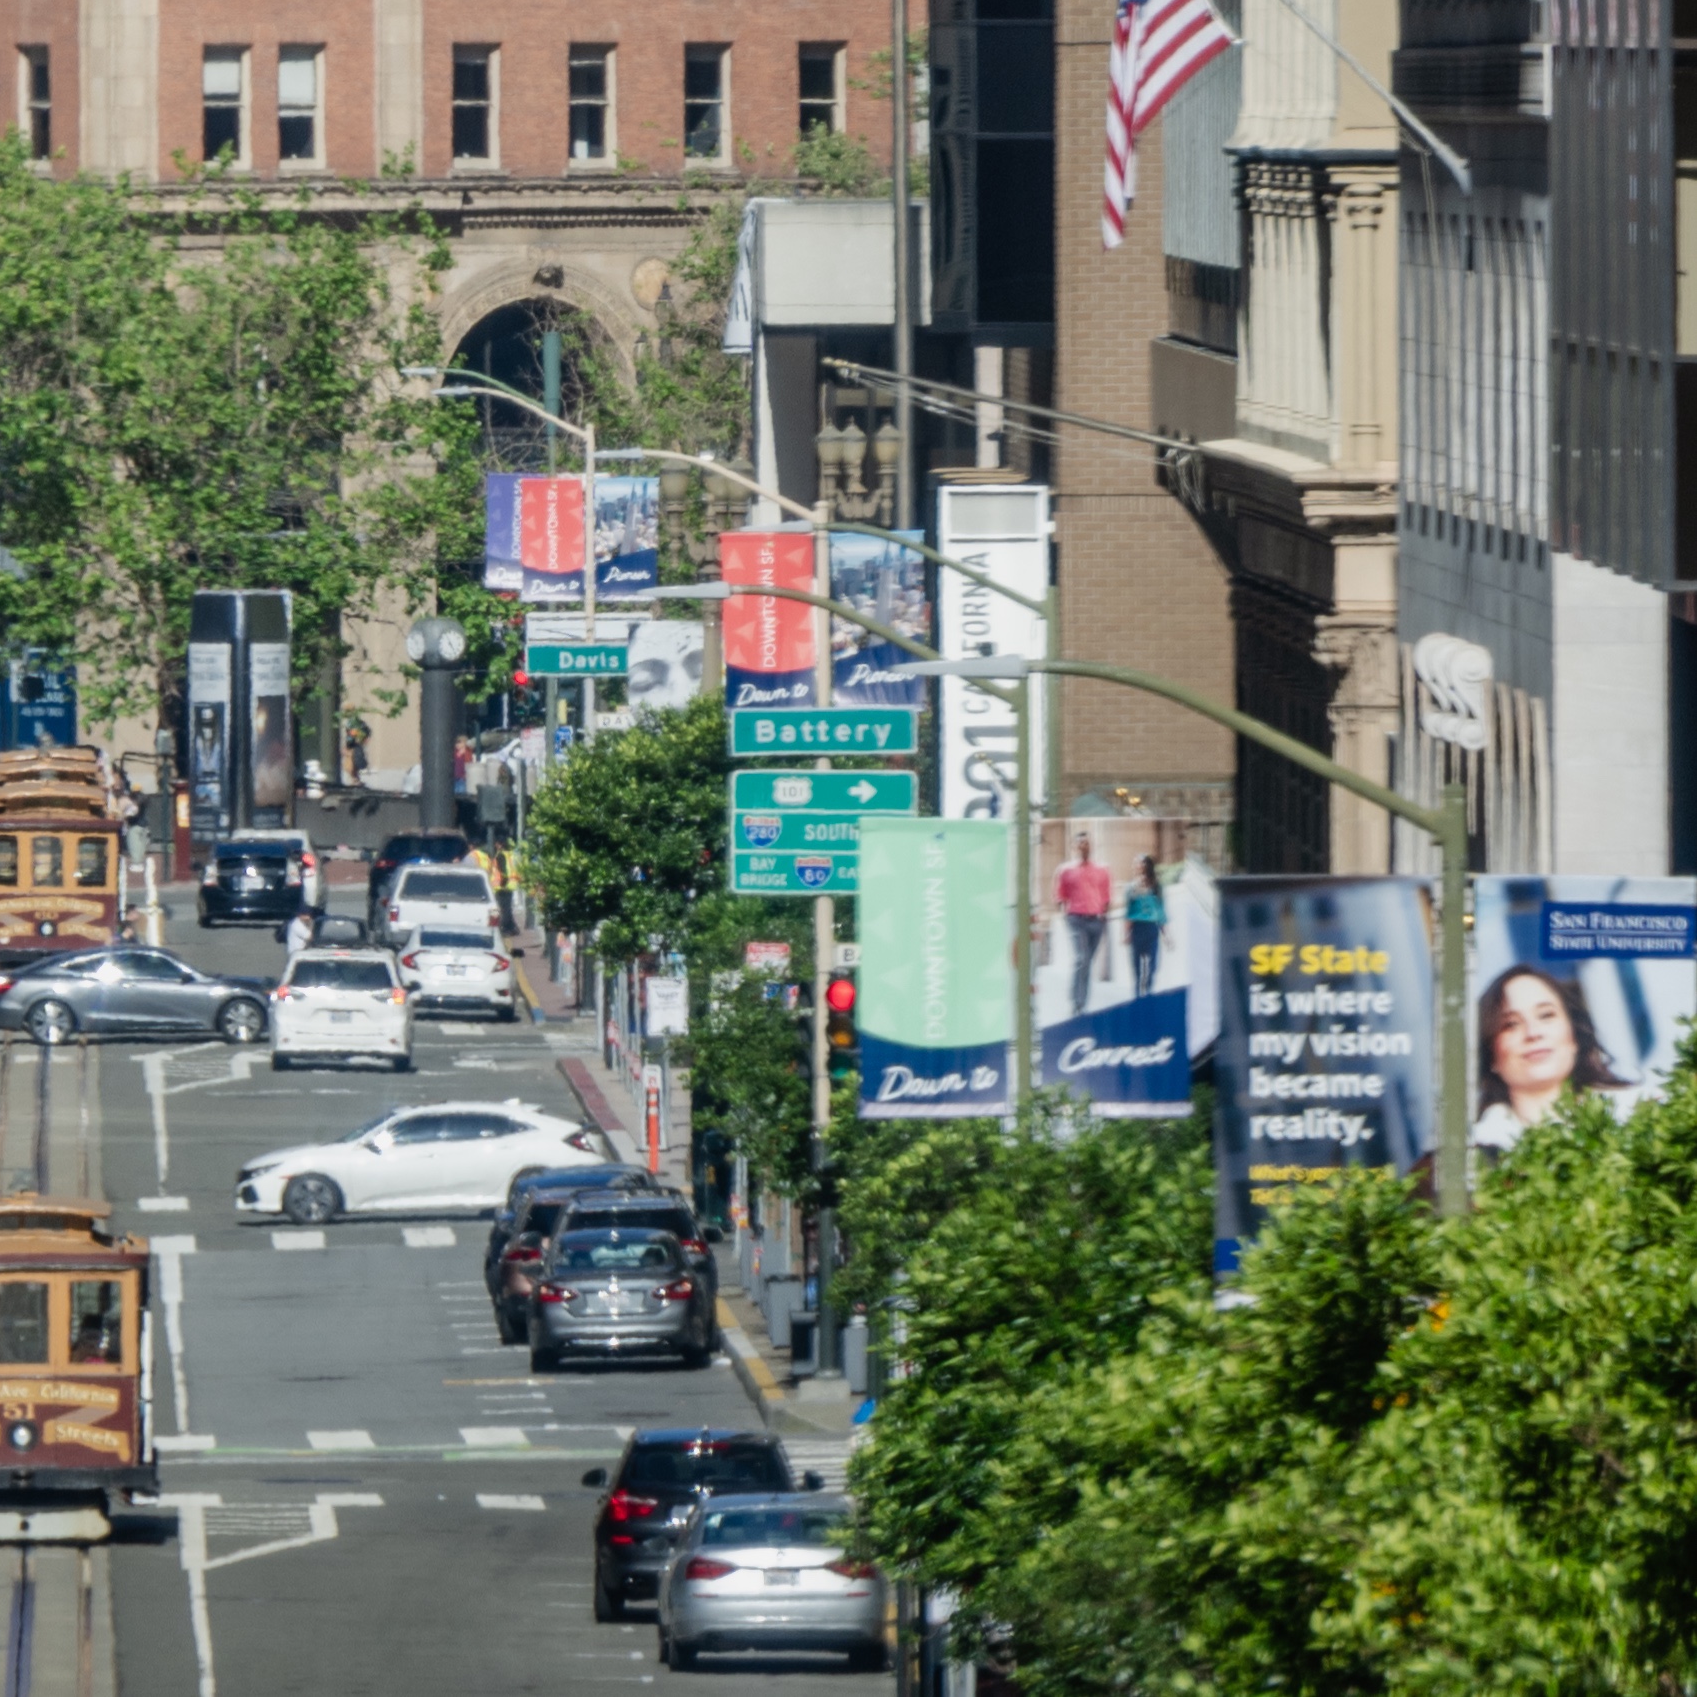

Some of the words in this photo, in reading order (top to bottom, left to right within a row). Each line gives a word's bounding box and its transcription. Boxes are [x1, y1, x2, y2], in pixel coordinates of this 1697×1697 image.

[547, 488, 557, 501] SF
[547, 503, 558, 570] DOWNTOWN
[761, 549, 774, 565] SF
[603, 566, 651, 584] Pioneer
[531, 577, 566, 595] Down
[569, 579, 580, 591] to
[559, 651, 619, 669] Davis
[736, 683, 790, 706] Down
[793, 683, 809, 698] to
[755, 719, 893, 748] Battery
[782, 785, 803, 797] 101
[747, 826, 777, 839] 280
[804, 823, 860, 841] SOUTH
[749, 857, 777, 871] BAY
[925, 842, 946, 869] SF
[740, 873, 788, 887] BRIDGE
[804, 869, 826, 883] 80
[1549, 910, 1587, 929] SAN
[1590, 911, 1688, 931] FRANCISCO
[1549, 934, 1594, 950] STATE
[1596, 935, 1687, 952] UNIVERSITY
[925, 878, 947, 1040] DOWNTOWN
[1249, 943, 1295, 976] SF
[1299, 943, 1390, 976] State
[1249, 983, 1282, 1016] is
[1285, 983, 1393, 1016] where
[1249, 1031, 1306, 1064] my
[1309, 1024, 1412, 1057] vision
[1058, 1036, 1176, 1074] Connect
[877, 1065, 967, 1102] Down
[969, 1064, 999, 1090] to
[1249, 1067, 1386, 1098] became
[1249, 1106, 1375, 1146] reality.
[0, 1385, 33, 1399] Ave.
[40, 1385, 118, 1403] California
[3, 1404, 36, 1419] 51
[55, 1425, 119, 1447] Streets
